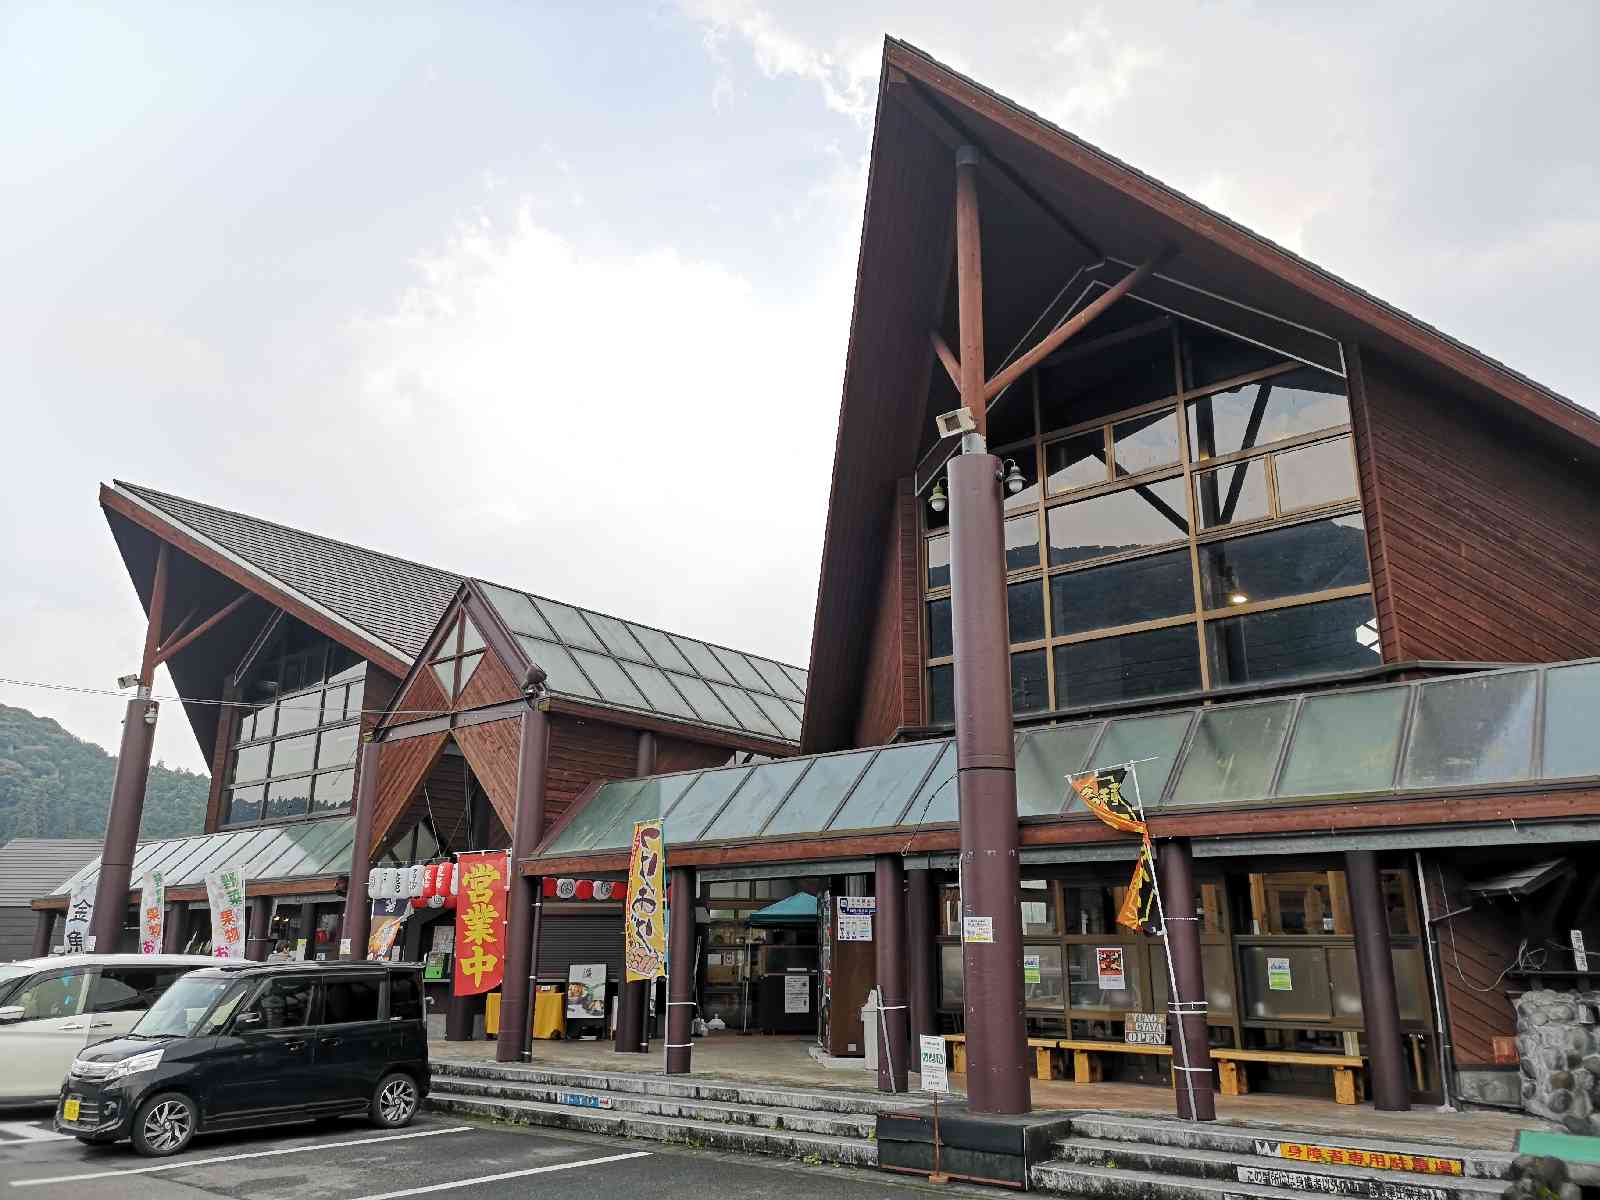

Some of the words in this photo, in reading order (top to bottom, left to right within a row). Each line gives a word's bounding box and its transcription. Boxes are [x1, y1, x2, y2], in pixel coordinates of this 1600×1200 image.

[66, 899, 93, 953] 金魚
[459, 863, 501, 988] 営業中
[1128, 1032, 1162, 1045] OPEN
